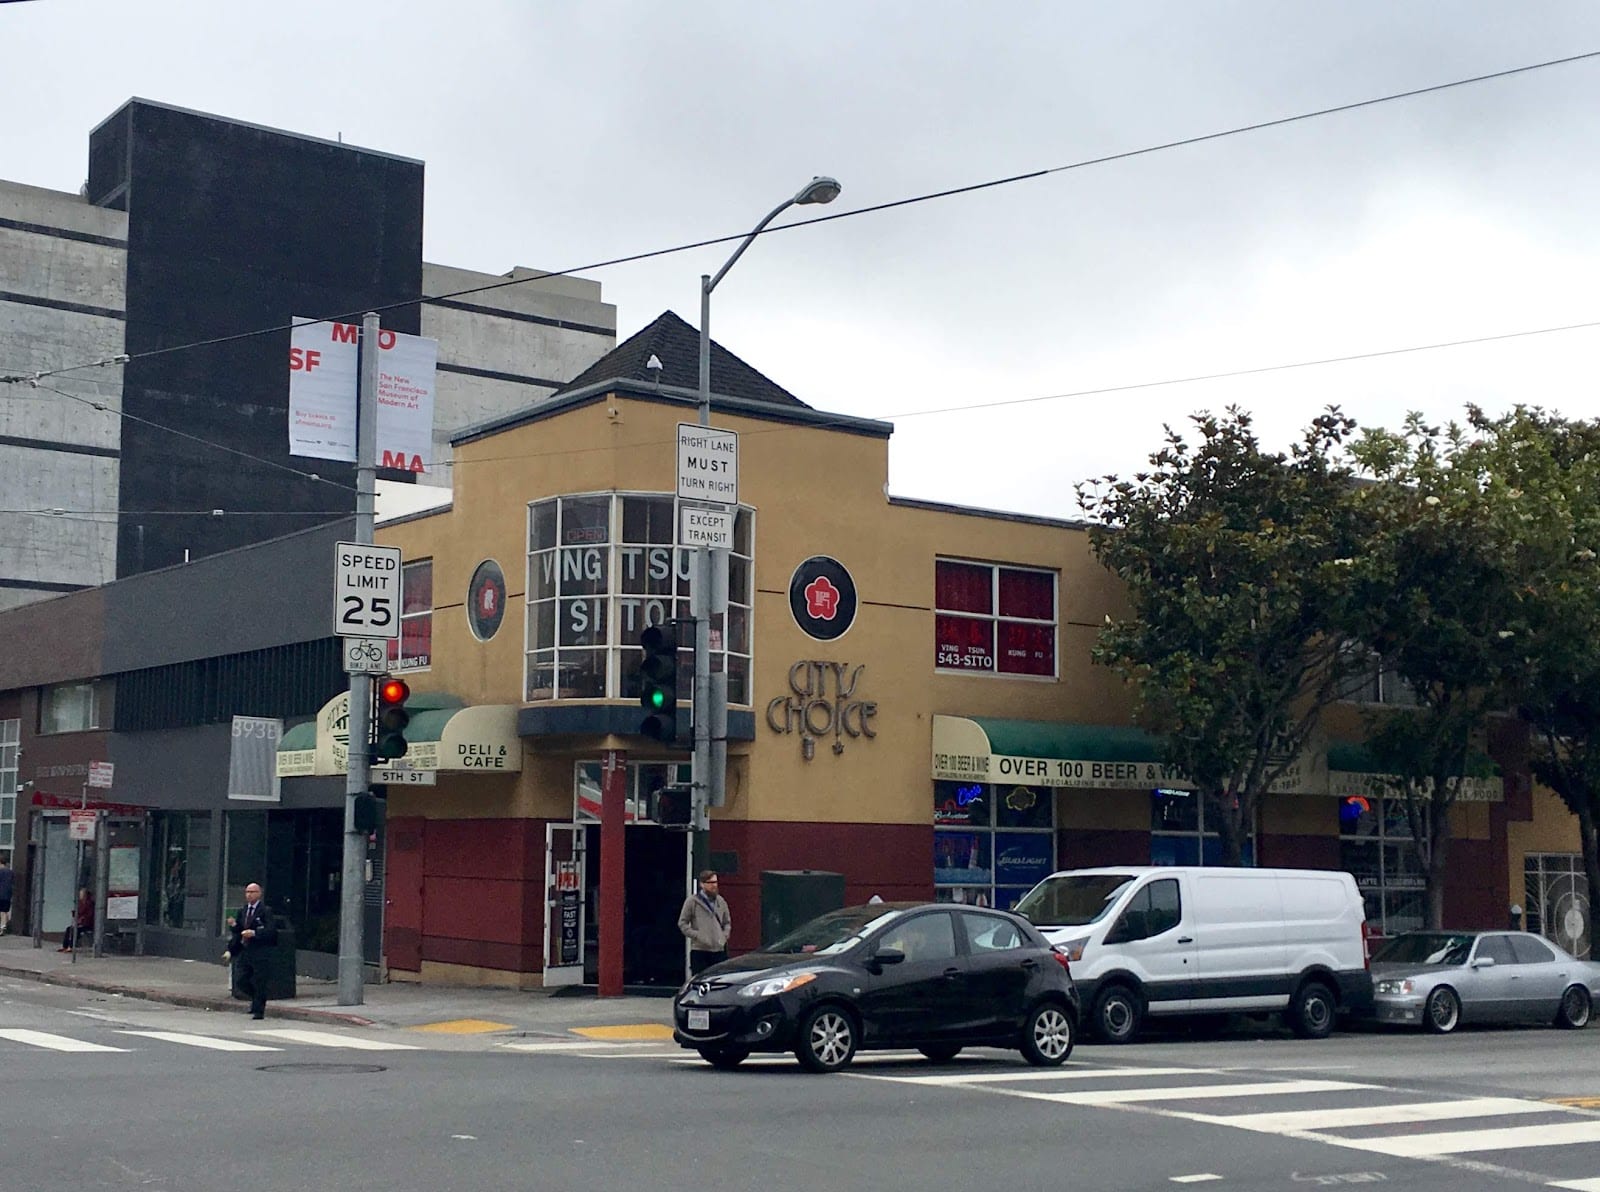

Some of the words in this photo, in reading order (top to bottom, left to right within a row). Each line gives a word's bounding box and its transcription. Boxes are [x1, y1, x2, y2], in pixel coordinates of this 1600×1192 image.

[332, 322, 358, 344] M
[290, 347, 321, 372] SF
[380, 373, 392, 381] The
[394, 376, 410, 384] New
[379, 380, 393, 389] San
[394, 384, 428, 395] Francisco
[379, 389, 409, 400] Museum
[378, 397, 406, 408] Modern
[407, 401, 419, 410] Art
[681, 436, 708, 449] RIGHT
[711, 440, 735, 453] LANE
[382, 449, 424, 473] MA
[687, 456, 728, 473] MUST
[681, 476, 705, 489] TURN
[708, 480, 735, 493] RIGHT
[690, 514, 725, 528] EXCEPT
[688, 529, 727, 543] TRANSIT
[342, 554, 396, 571] SPEED
[542, 548, 602, 585] VNG
[346, 574, 390, 589] LIMIT
[342, 595, 392, 627] 25
[941, 643, 959, 653] VING
[968, 646, 986, 655] TSUN
[1008, 649, 1027, 658] KUNG
[1034, 650, 1044, 659] FU
[418, 655, 428, 665] FU
[938, 652, 993, 668] 543-SITO
[767, 695, 878, 738] CHOICE
[458, 744, 491, 756] DELI
[498, 745, 508, 756] &
[463, 756, 504, 768] CAFE
[999, 758, 1048, 777] OVER
[1057, 761, 1084, 778] 100
[1092, 763, 1138, 780] BEER
[1146, 765, 1157, 780] &
[382, 772, 404, 781] 5TH
[410, 773, 424, 782] ST
